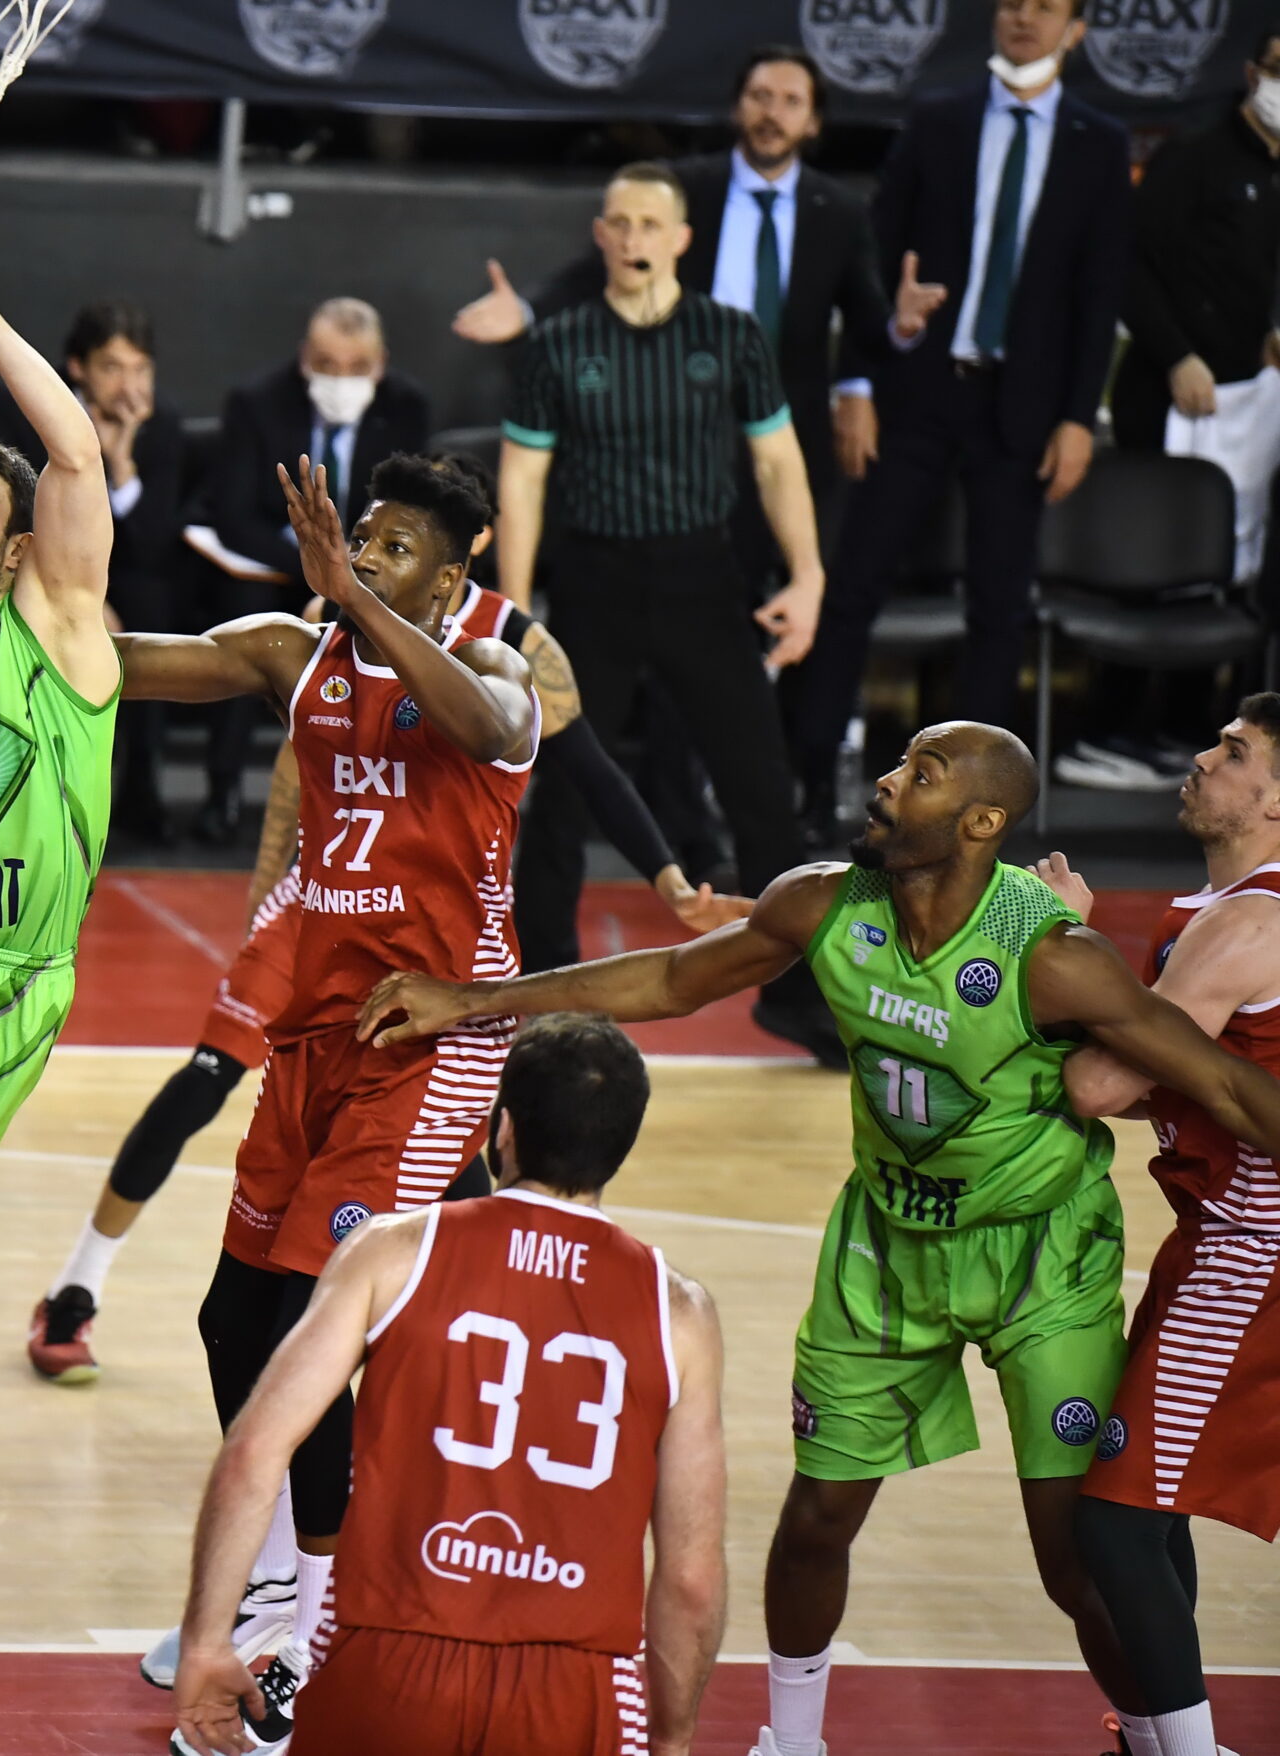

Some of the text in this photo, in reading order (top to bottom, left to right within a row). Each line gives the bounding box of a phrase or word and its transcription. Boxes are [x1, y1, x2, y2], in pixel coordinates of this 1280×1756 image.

[322, 808, 384, 871] 77
[868, 985, 950, 1048] TOFAŞ
[878, 1057, 930, 1126] 11
[508, 1228, 589, 1284] MAYE
[433, 1310, 627, 1491] 33
[437, 1535, 585, 1589] innubo
